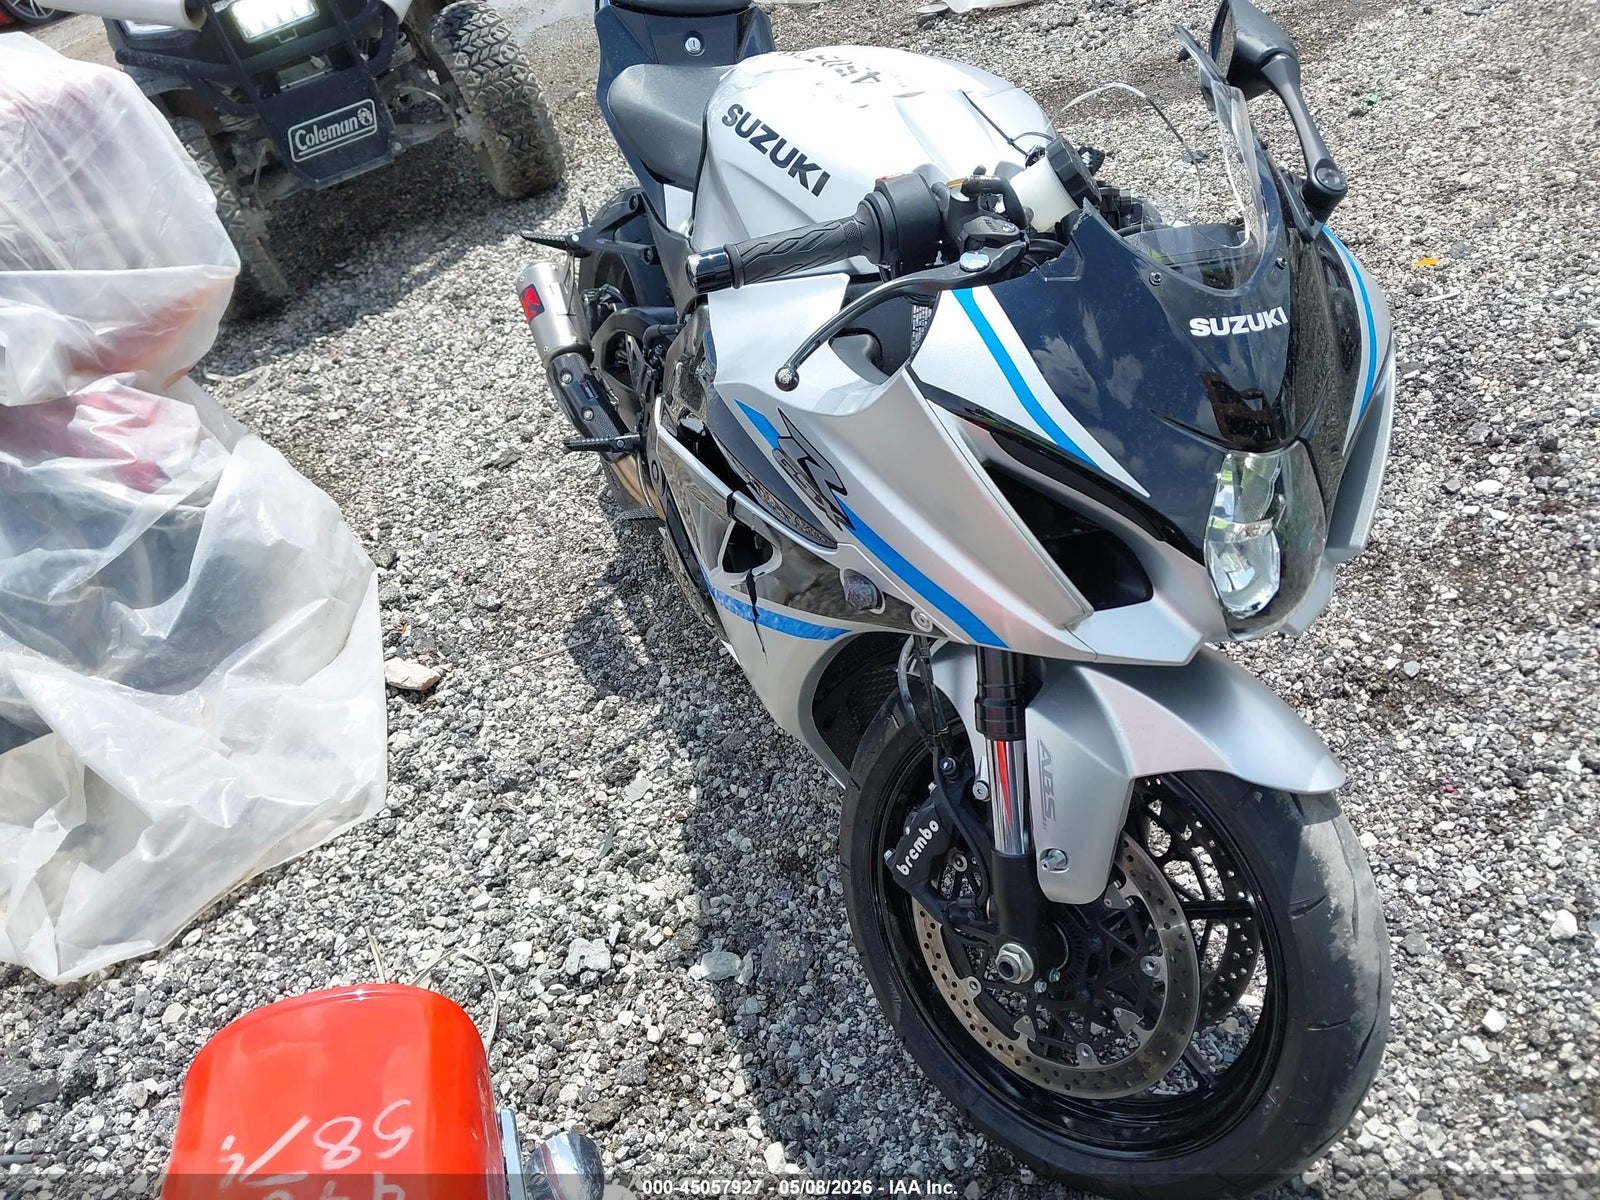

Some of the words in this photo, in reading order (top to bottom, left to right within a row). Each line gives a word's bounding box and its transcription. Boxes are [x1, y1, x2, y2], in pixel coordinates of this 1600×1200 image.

[294, 116, 359, 151] Coleman
[721, 103, 831, 198] SUZUKI
[1189, 306, 1289, 337] SUZUKI
[896, 820, 939, 876] brembo
